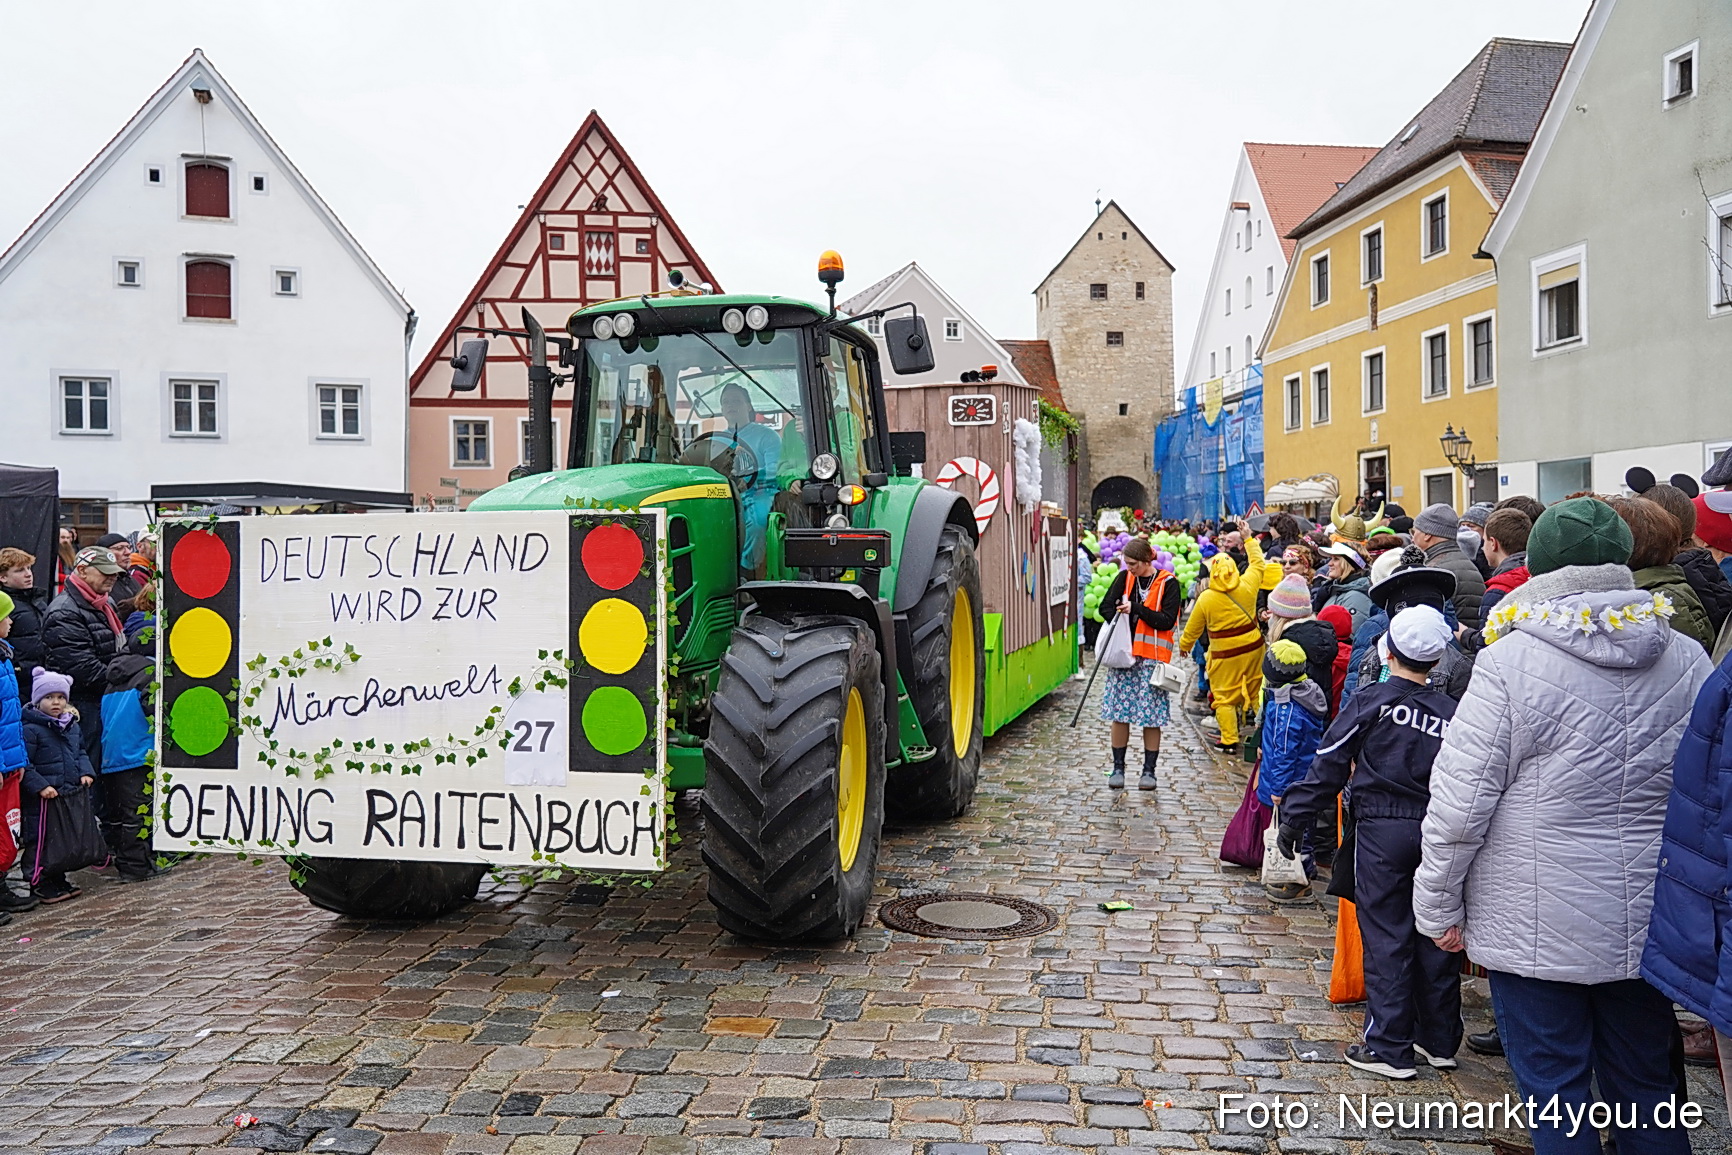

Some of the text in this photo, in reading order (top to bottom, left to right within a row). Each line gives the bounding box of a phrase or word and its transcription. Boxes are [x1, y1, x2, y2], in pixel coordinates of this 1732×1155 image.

[260, 533, 549, 583] DEUTSCHLAND
[330, 587, 498, 622] WIRD ZUR
[269, 664, 503, 732] Märchenwelt
[512, 720, 556, 753] 27
[164, 784, 660, 858] OENING RAITENBUCH
